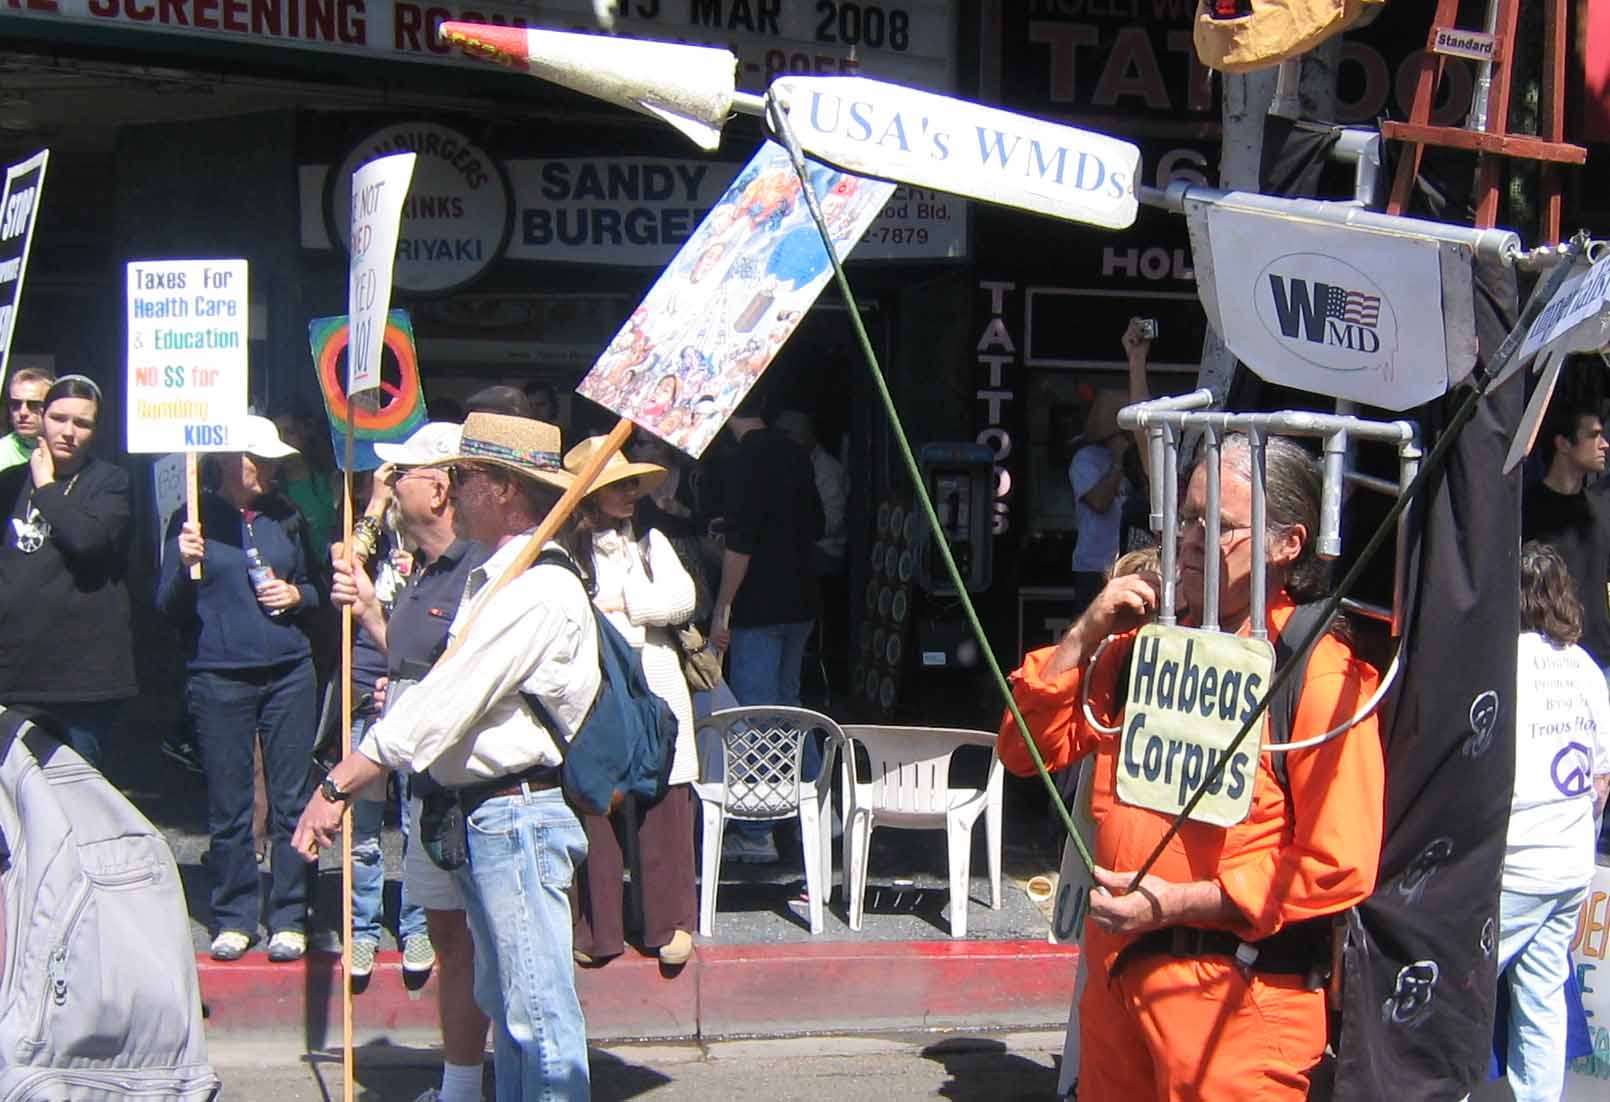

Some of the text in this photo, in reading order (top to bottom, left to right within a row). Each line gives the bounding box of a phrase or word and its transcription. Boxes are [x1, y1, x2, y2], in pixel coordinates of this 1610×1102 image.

[395, 3, 527, 57] RO
[815, 2, 909, 51] 2008
[1438, 33, 1494, 53] Standard
[1029, 21, 1474, 126] TATOO
[809, 92, 1126, 201] USA's WMDs
[541, 161, 709, 201] SANDY
[403, 195, 465, 220] INKS
[522, 207, 709, 246] BURGE
[135, 268, 233, 290] Taxes For
[134, 296, 238, 319] Health Care
[154, 327, 239, 351] Education
[135, 366, 159, 388] NO
[191, 366, 221, 388] for
[184, 424, 229, 447] KIDS!
[1132, 635, 1264, 726] Habeas
[1124, 712, 1250, 807] Corpus
